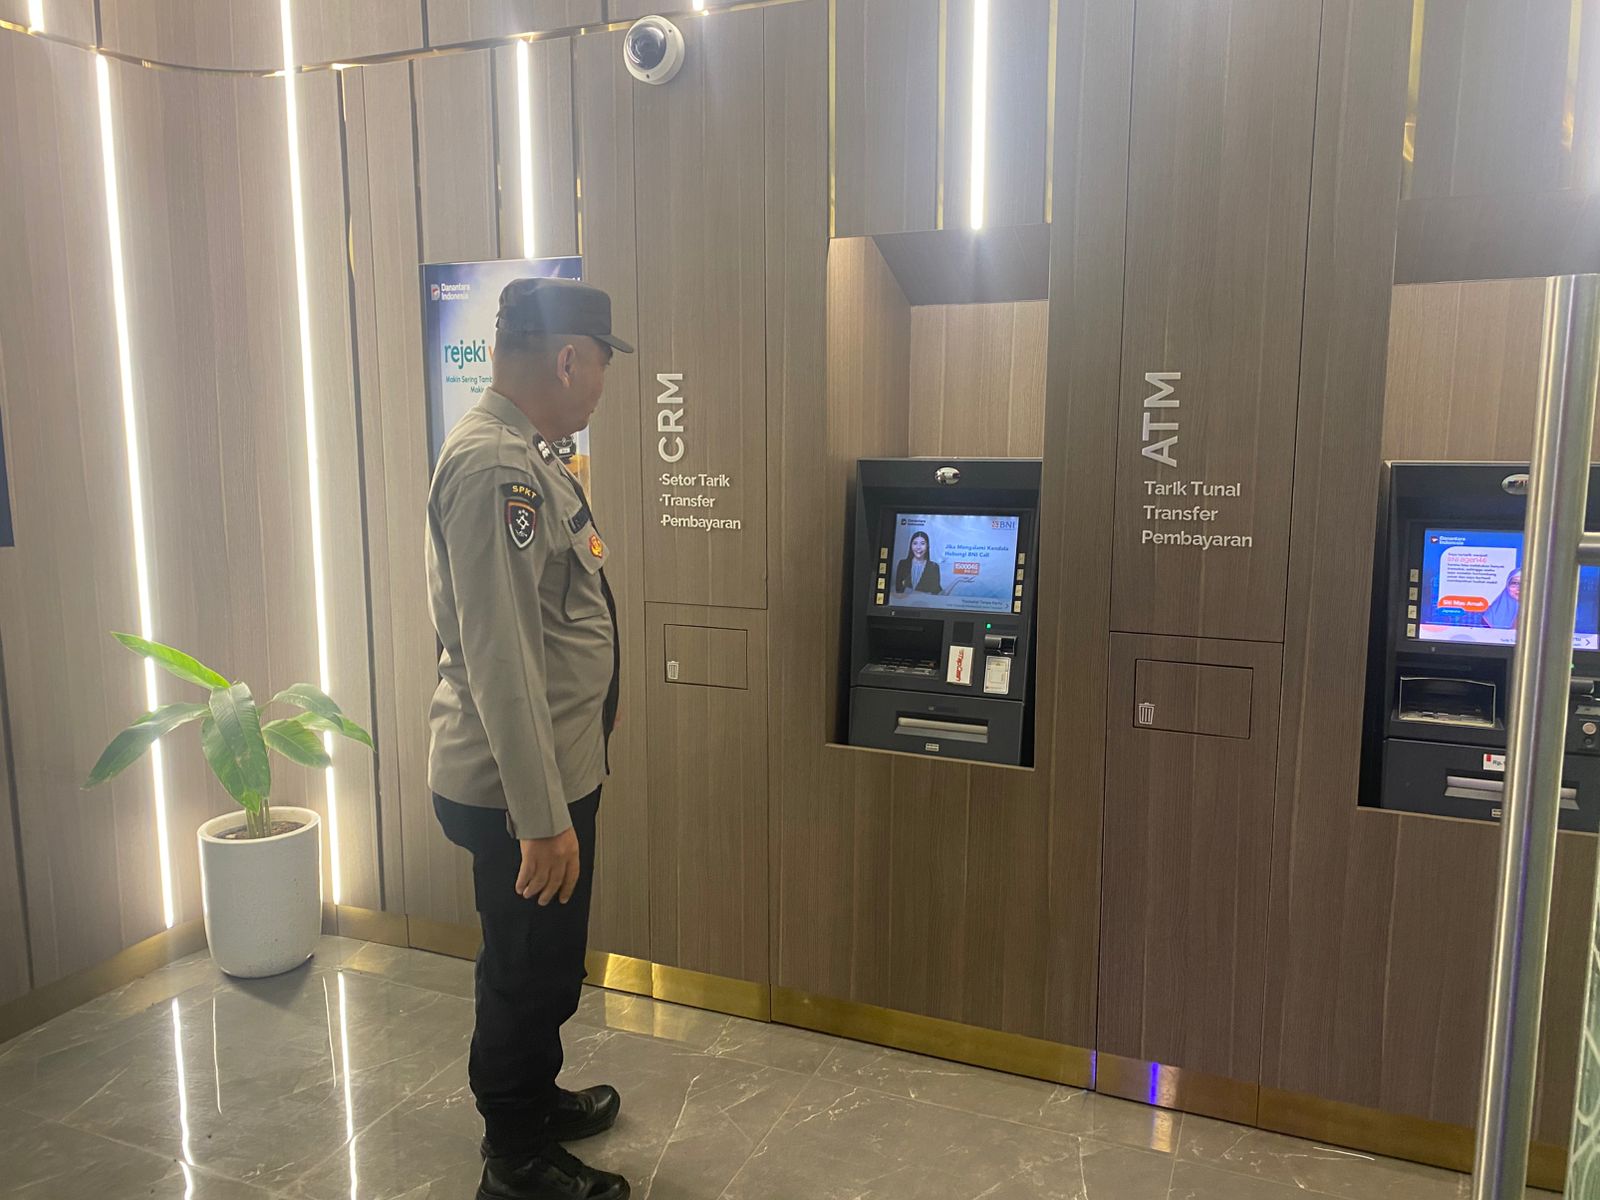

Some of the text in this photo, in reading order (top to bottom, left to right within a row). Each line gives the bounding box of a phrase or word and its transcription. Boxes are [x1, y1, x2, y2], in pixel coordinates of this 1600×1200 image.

[444, 339, 486, 369] rejeki
[462, 376, 478, 385] Sering
[656, 373, 685, 463] CRM
[1141, 371, 1182, 468] ATM
[698, 474, 730, 487] Tarik
[512, 485, 537, 499] SPKT
[1143, 505, 1219, 521] Transfer
[1000, 521, 1015, 529] BNI
[1142, 530, 1252, 550] Pembayaran
